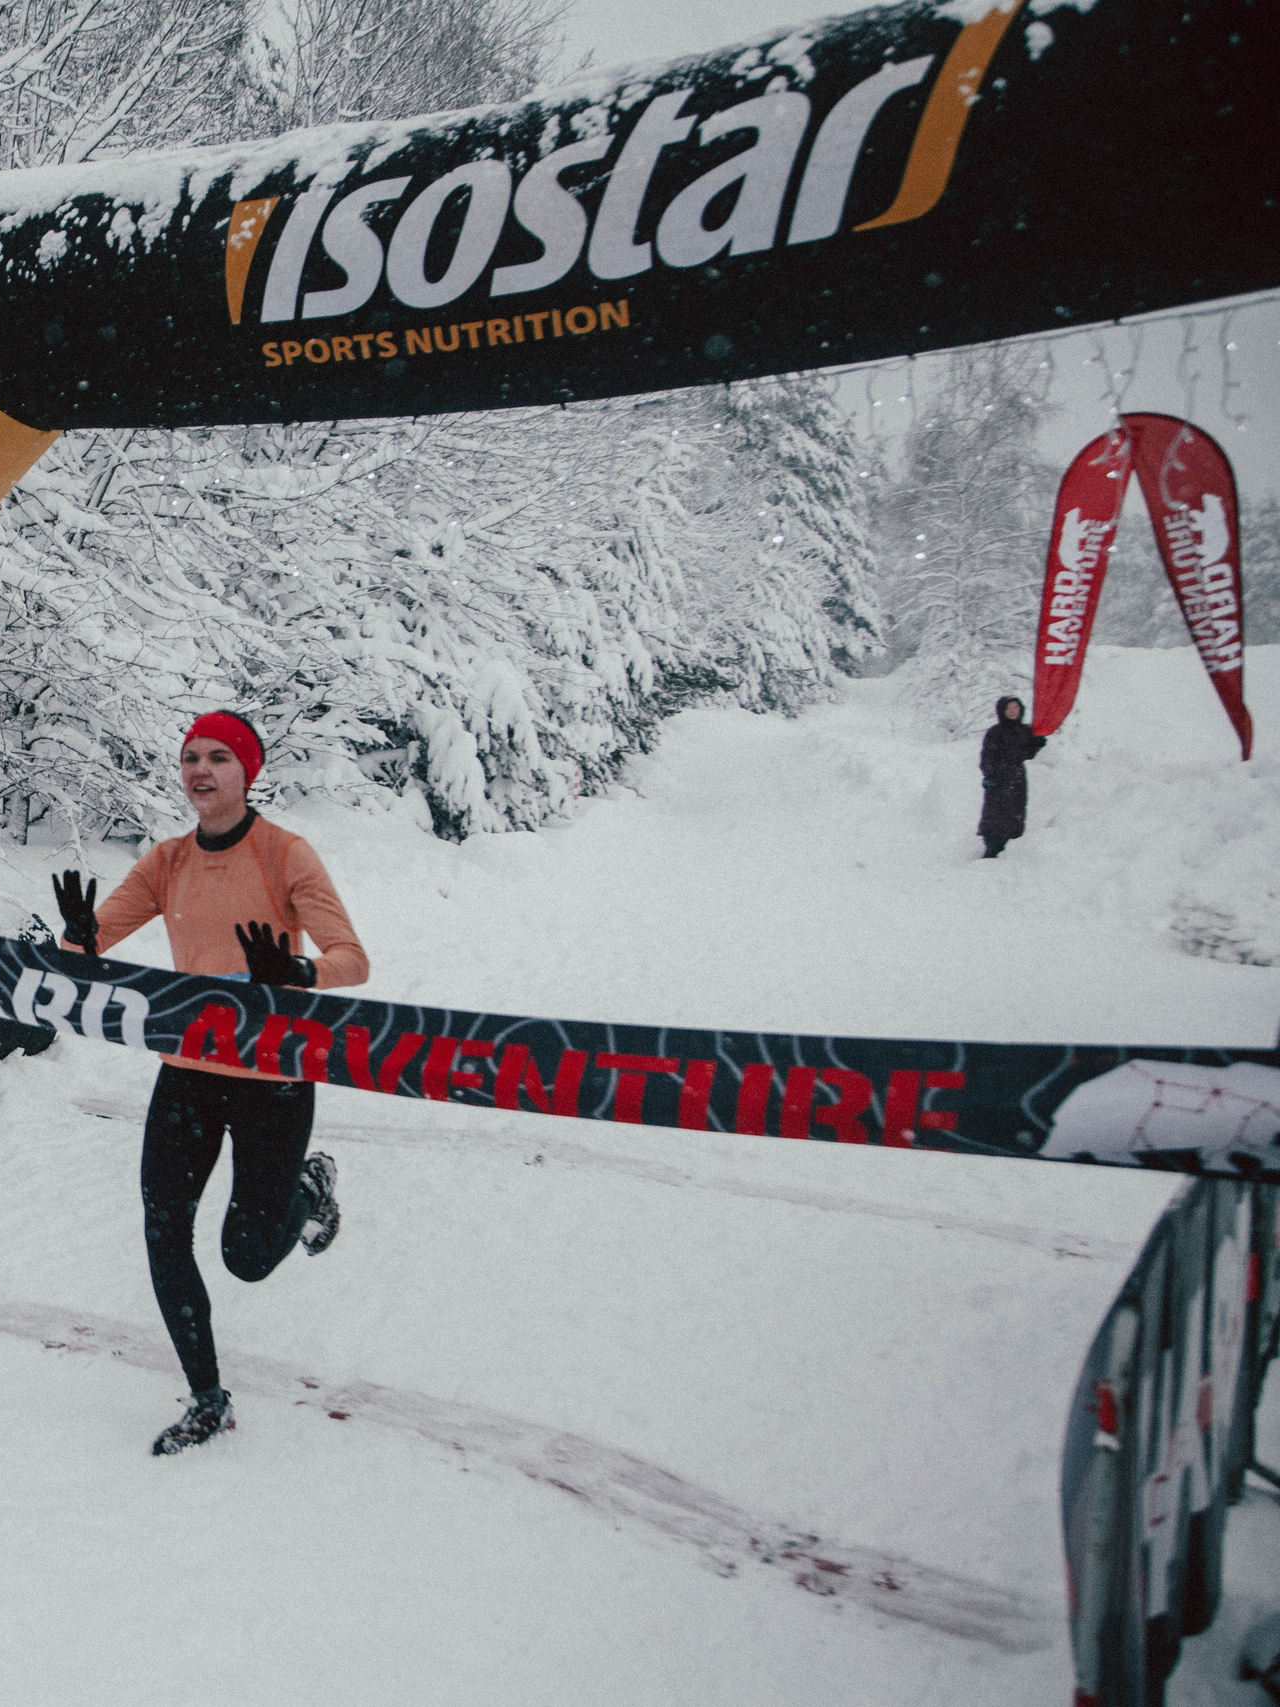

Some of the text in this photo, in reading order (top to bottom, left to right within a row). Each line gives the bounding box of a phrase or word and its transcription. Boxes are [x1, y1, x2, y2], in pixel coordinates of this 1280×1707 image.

[261, 299, 630, 367] SPORTS NUTRITION
[1044, 570, 1080, 665] HARD
[180, 1003, 967, 1153] ADVENTURE
